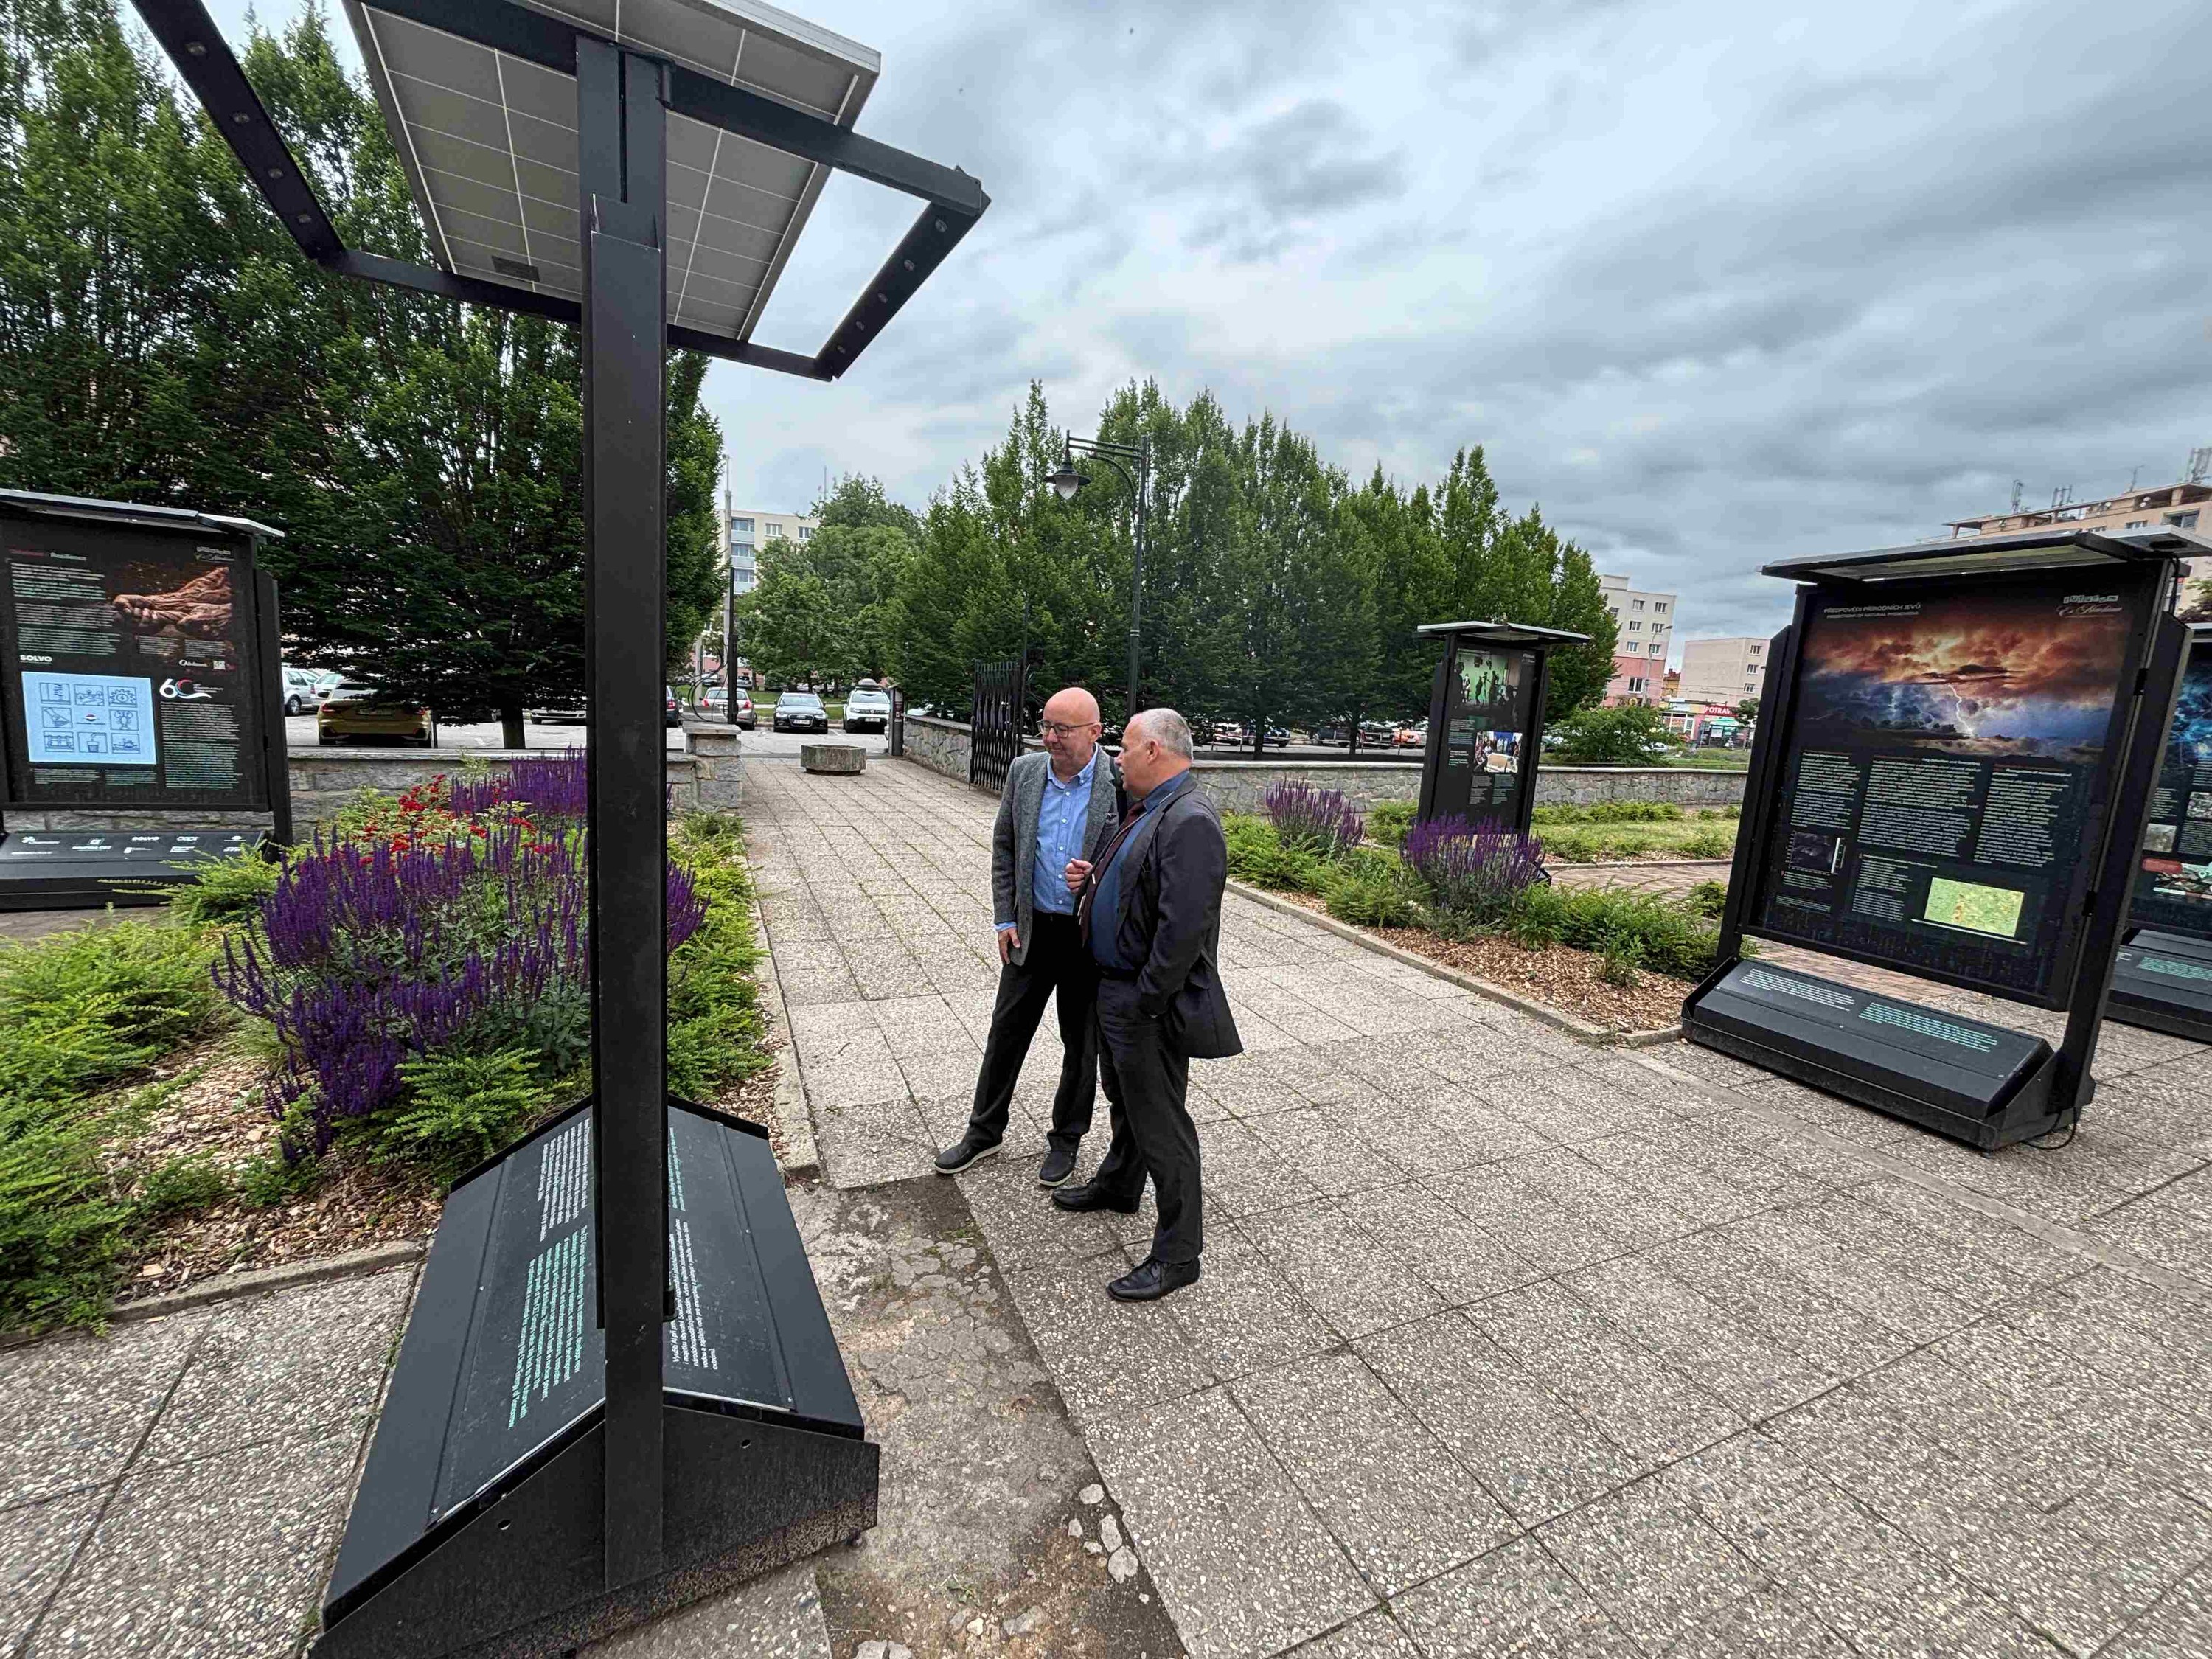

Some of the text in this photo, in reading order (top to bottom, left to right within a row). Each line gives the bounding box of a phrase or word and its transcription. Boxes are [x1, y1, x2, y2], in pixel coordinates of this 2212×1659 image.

[20, 654, 52, 663] SOLVO
[1705, 706, 1733, 715] POTRAV
[512, 1368, 522, 1390] Energy
